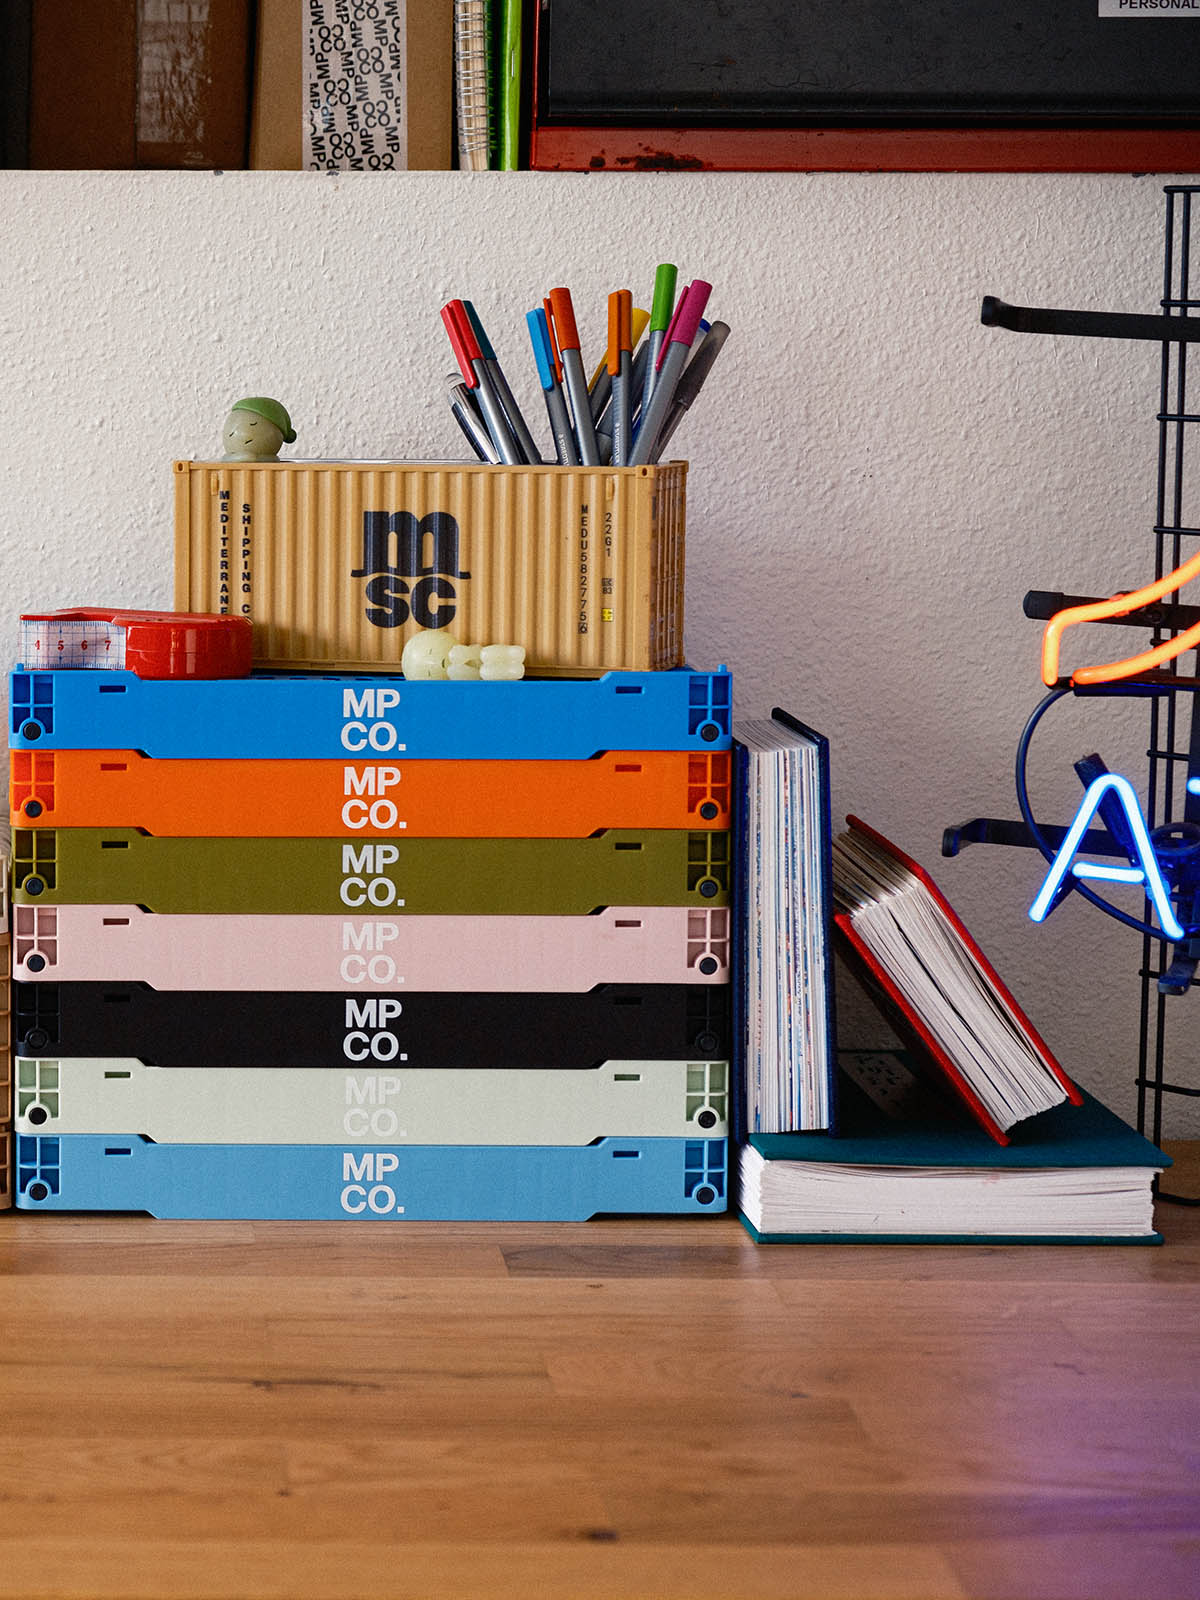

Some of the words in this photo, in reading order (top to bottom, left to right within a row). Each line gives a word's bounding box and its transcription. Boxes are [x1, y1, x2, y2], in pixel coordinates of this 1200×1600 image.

[242, 504, 251, 593] SHIPPING
[605, 512, 613, 557] 22G1
[34, 640, 41, 651] 4
[57, 640, 64, 651] 5
[81, 640, 88, 651] 6
[104, 640, 112, 651] 7
[342, 688, 401, 718] MP
[340, 721, 407, 752] CO.
[343, 766, 402, 796] MP
[341, 799, 407, 830] CO.
[341, 844, 400, 874] MP
[1028, 773, 1200, 940] A
[339, 876, 405, 907] CO.
[342, 922, 400, 951] MP
[339, 954, 405, 984] CO.
[345, 999, 403, 1028] MP
[342, 1031, 408, 1061] CO.
[345, 1076, 402, 1105] MP
[343, 1108, 408, 1137] CO.
[342, 1152, 400, 1181] MP
[340, 1184, 405, 1214] CO.
